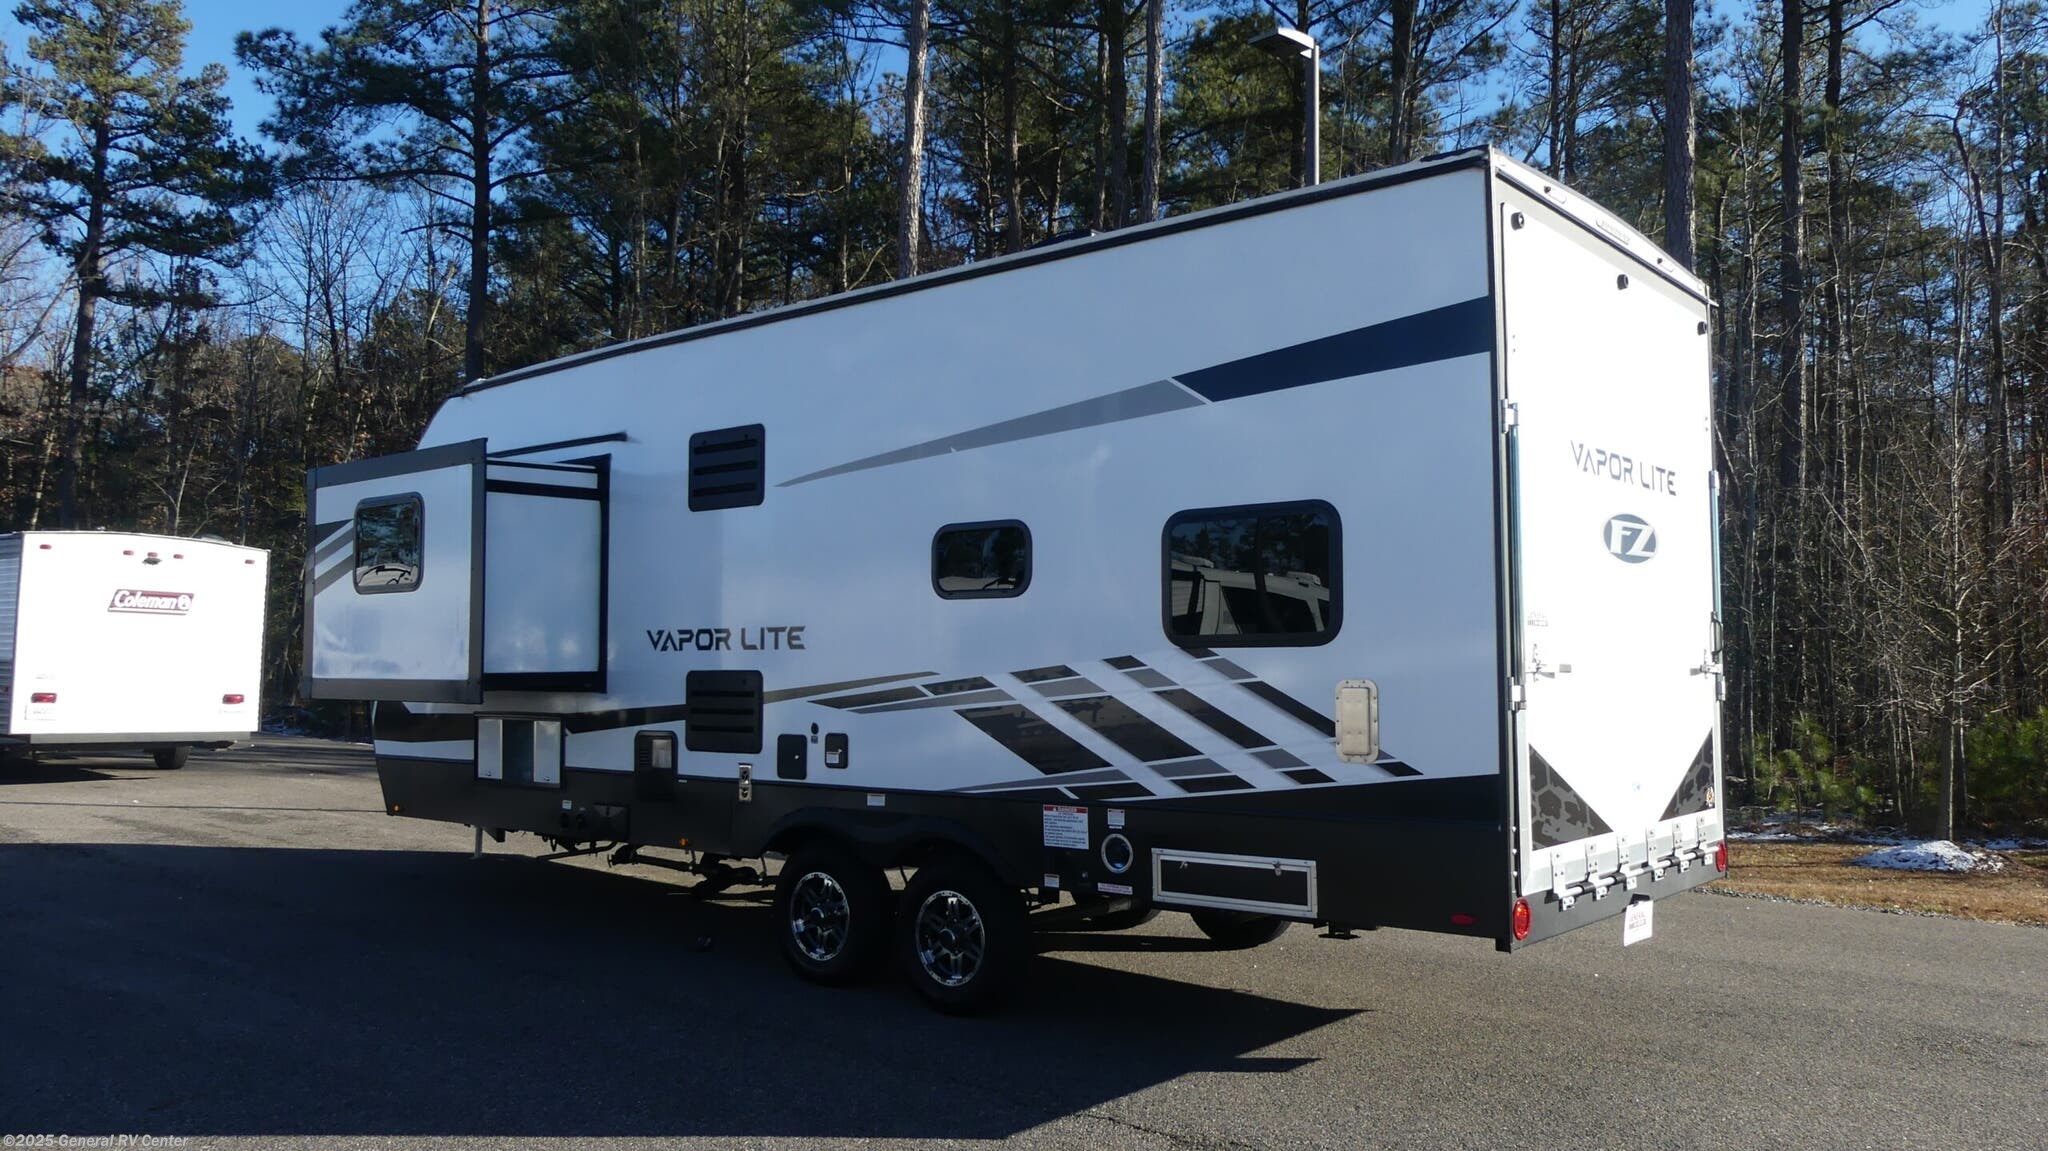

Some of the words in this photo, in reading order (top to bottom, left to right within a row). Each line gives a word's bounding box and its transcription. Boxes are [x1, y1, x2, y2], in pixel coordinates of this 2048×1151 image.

[1570, 439, 1634, 485] VAPOR
[1640, 460, 1677, 497] LITE
[1609, 519, 1657, 558] FZ
[114, 589, 177, 609] Coleman
[646, 628, 732, 652] VAPOR
[741, 625, 807, 650] LITE
